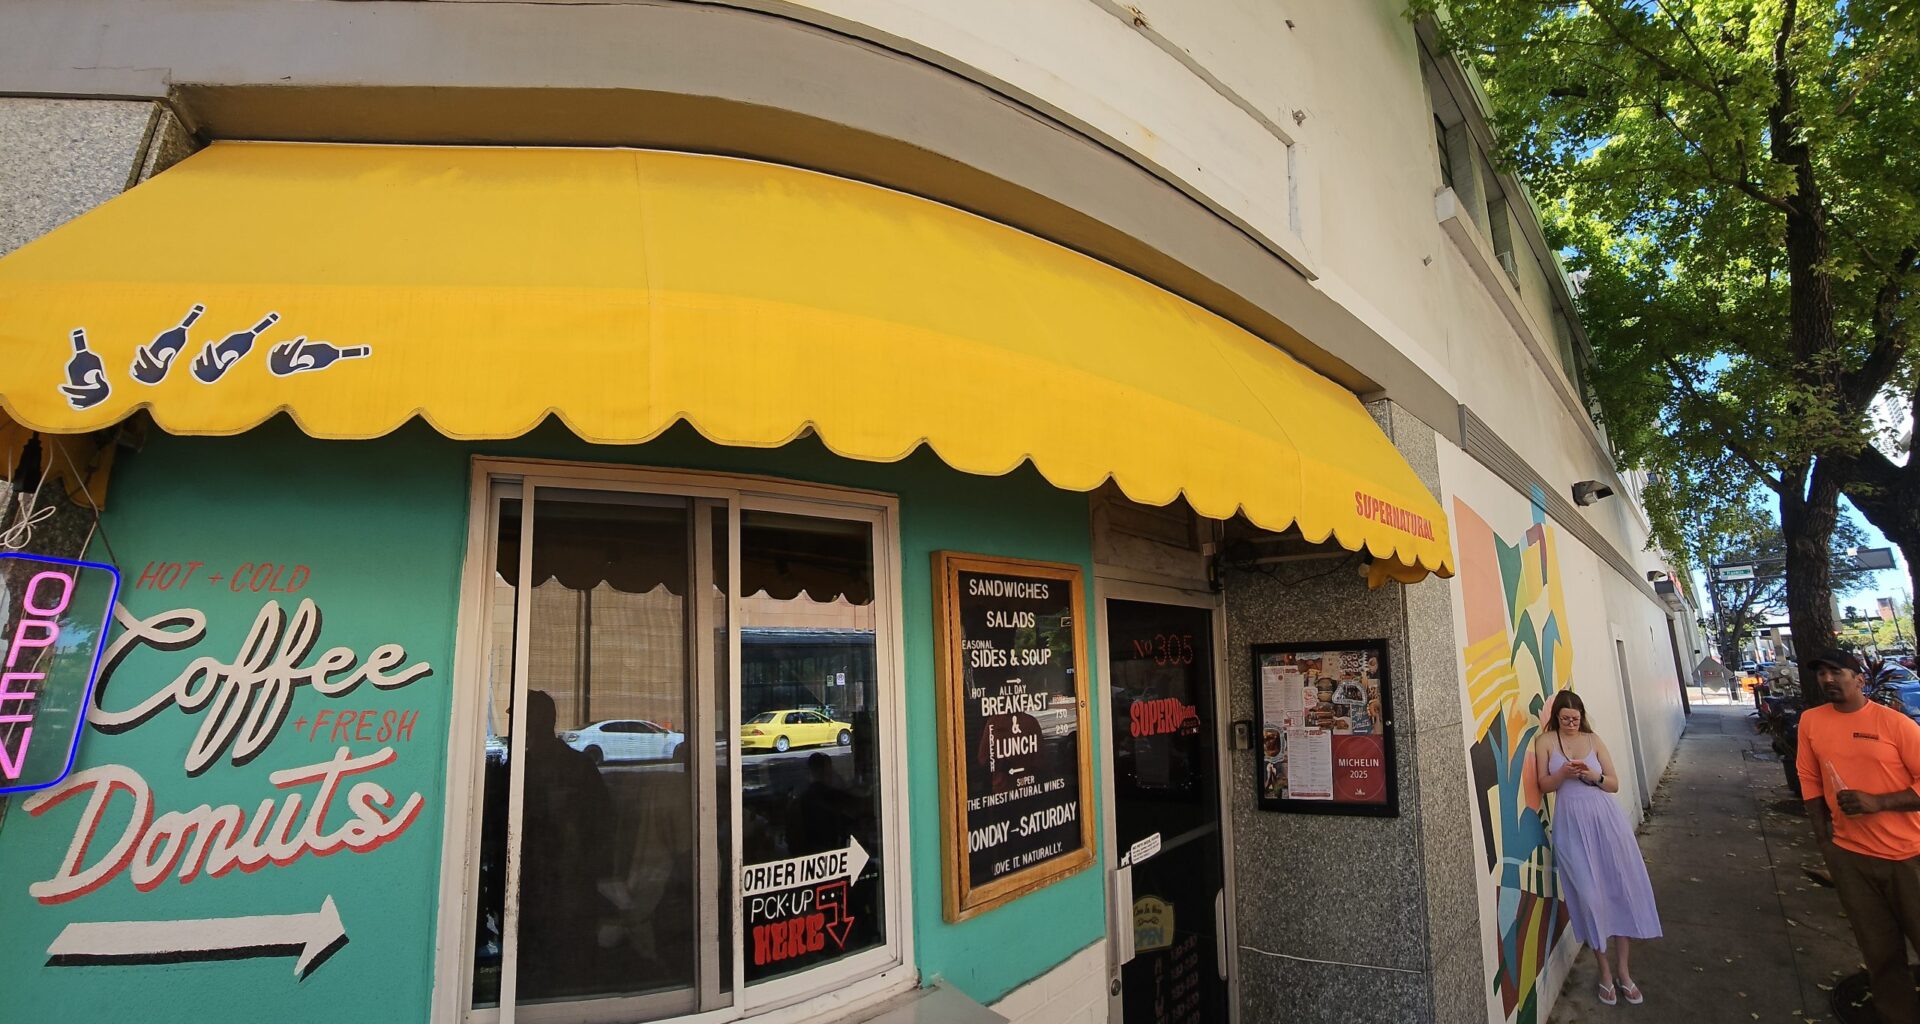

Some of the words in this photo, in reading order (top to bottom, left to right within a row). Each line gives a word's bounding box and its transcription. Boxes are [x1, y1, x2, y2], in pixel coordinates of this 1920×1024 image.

[1354, 491, 1435, 542] SUPERNATURAL
[136, 561, 204, 591] HOT
[229, 562, 312, 593] COLD
[969, 578, 1049, 599] SANDWICHES
[986, 611, 1036, 628] SALADS
[962, 639, 993, 650] EASONAL
[1154, 634, 1193, 666] 305
[971, 649, 1007, 667] SIDES
[1010, 650, 1020, 667] &
[1021, 648, 1052, 666] SOUP
[90, 597, 434, 778] Coffee
[971, 687, 986, 699] HOT
[999, 685, 1013, 696] ALL
[1014, 684, 1027, 695] DAY
[981, 692, 1049, 717] BREAKFAST
[1011, 715, 1022, 734] &
[996, 734, 1038, 759] LUNCH
[1338, 758, 1379, 767] MICHELIN
[1350, 769, 1368, 779] 2025
[967, 797, 981, 812] THE
[982, 791, 1008, 808] FINEST
[1008, 784, 1042, 802] NATURAL
[1044, 778, 1065, 793] WINES
[22, 746, 425, 906] Donuts
[1020, 801, 1077, 837] SATURDAY
[799, 852, 848, 883] INSIDE
[752, 912, 825, 966] HERE
